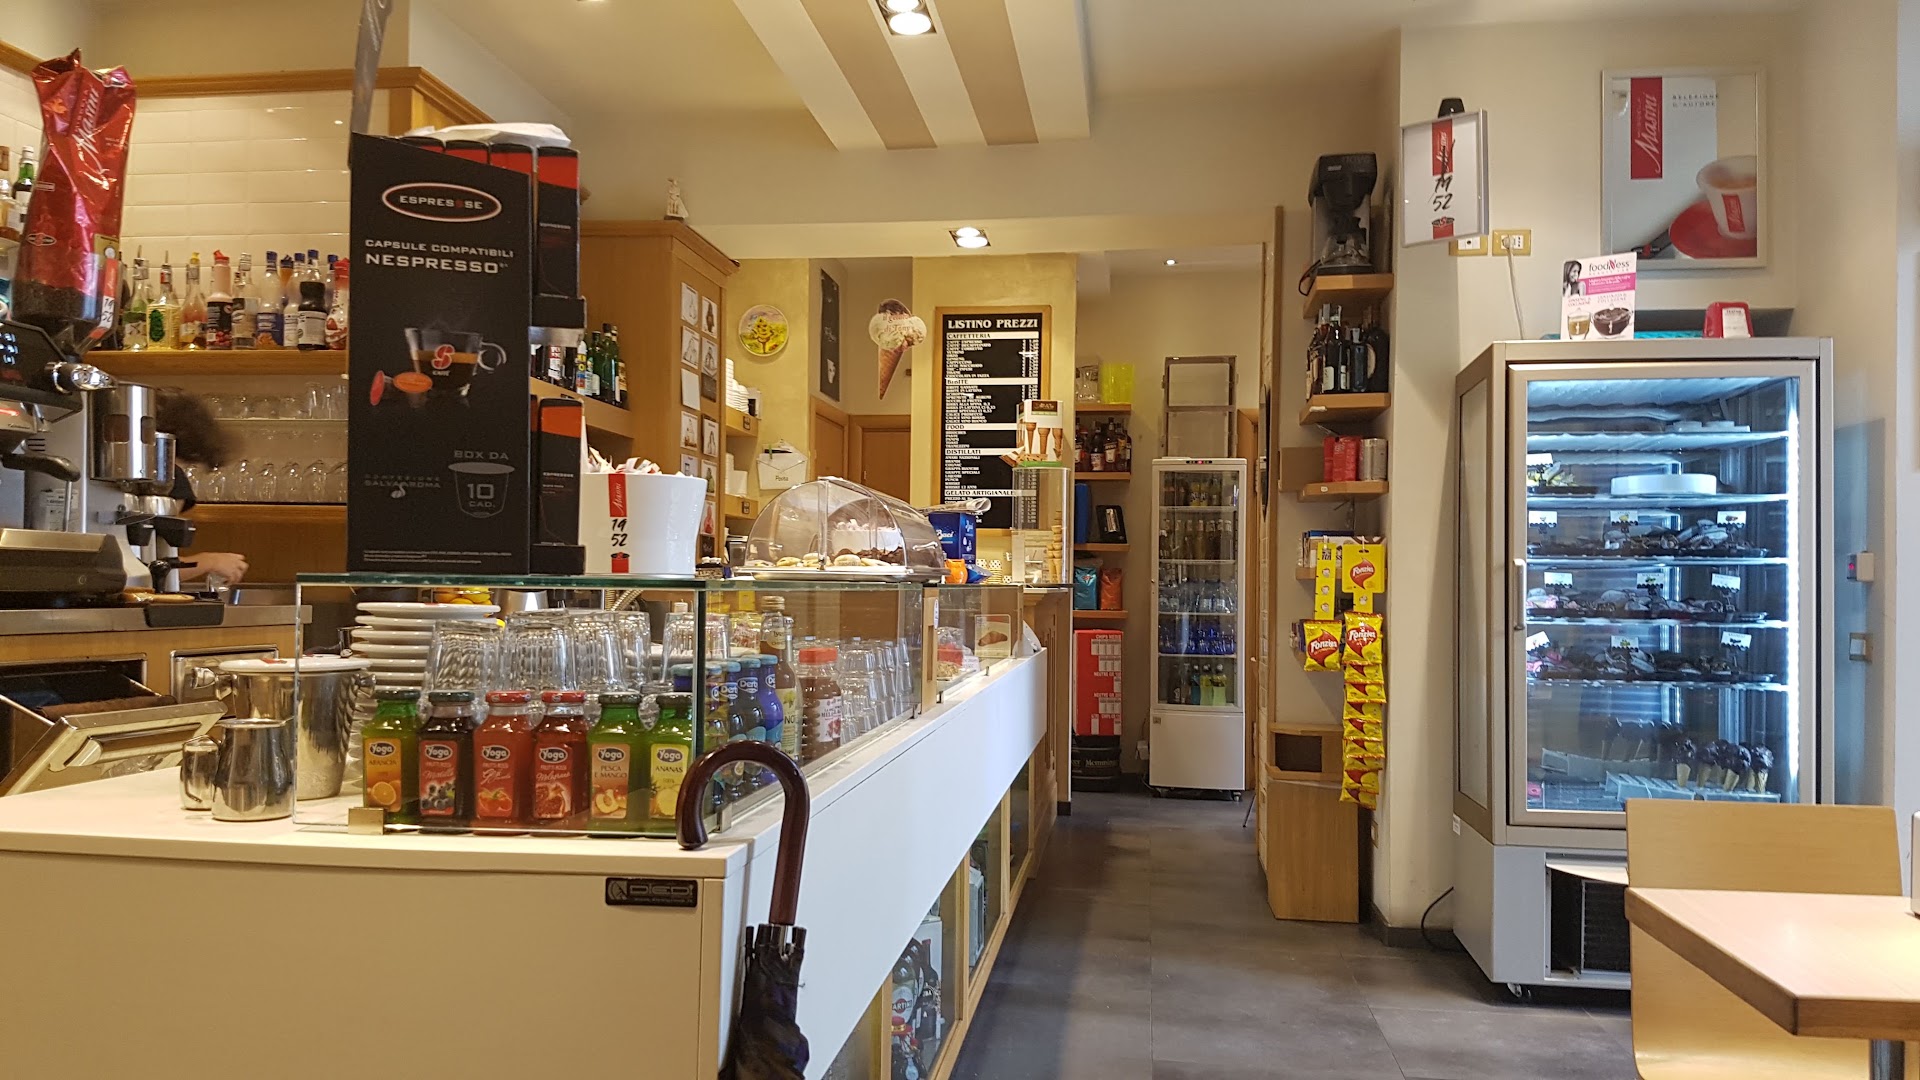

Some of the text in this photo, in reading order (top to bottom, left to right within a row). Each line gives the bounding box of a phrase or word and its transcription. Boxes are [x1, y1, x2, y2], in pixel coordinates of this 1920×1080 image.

[1433, 193, 1453, 212] 52
[365, 239, 514, 258] CAPSULE COMPATIBILI
[365, 253, 499, 274] NESPRESSO
[947, 318, 1038, 329] LISTINO PREZZI
[454, 450, 509, 460] BOX DA
[467, 483, 495, 499] 10
[612, 518, 628, 532] 19
[611, 533, 628, 547] 52
[1353, 566, 1374, 577] Fonzies
[1311, 640, 1338, 653] Fonzies
[370, 743, 393, 756] Yoga
[426, 745, 449, 759] Yoga
[483, 746, 507, 760] Yoga
[540, 748, 565, 761] Yoga
[598, 748, 623, 762] Yoga
[656, 748, 682, 762] Yoga
